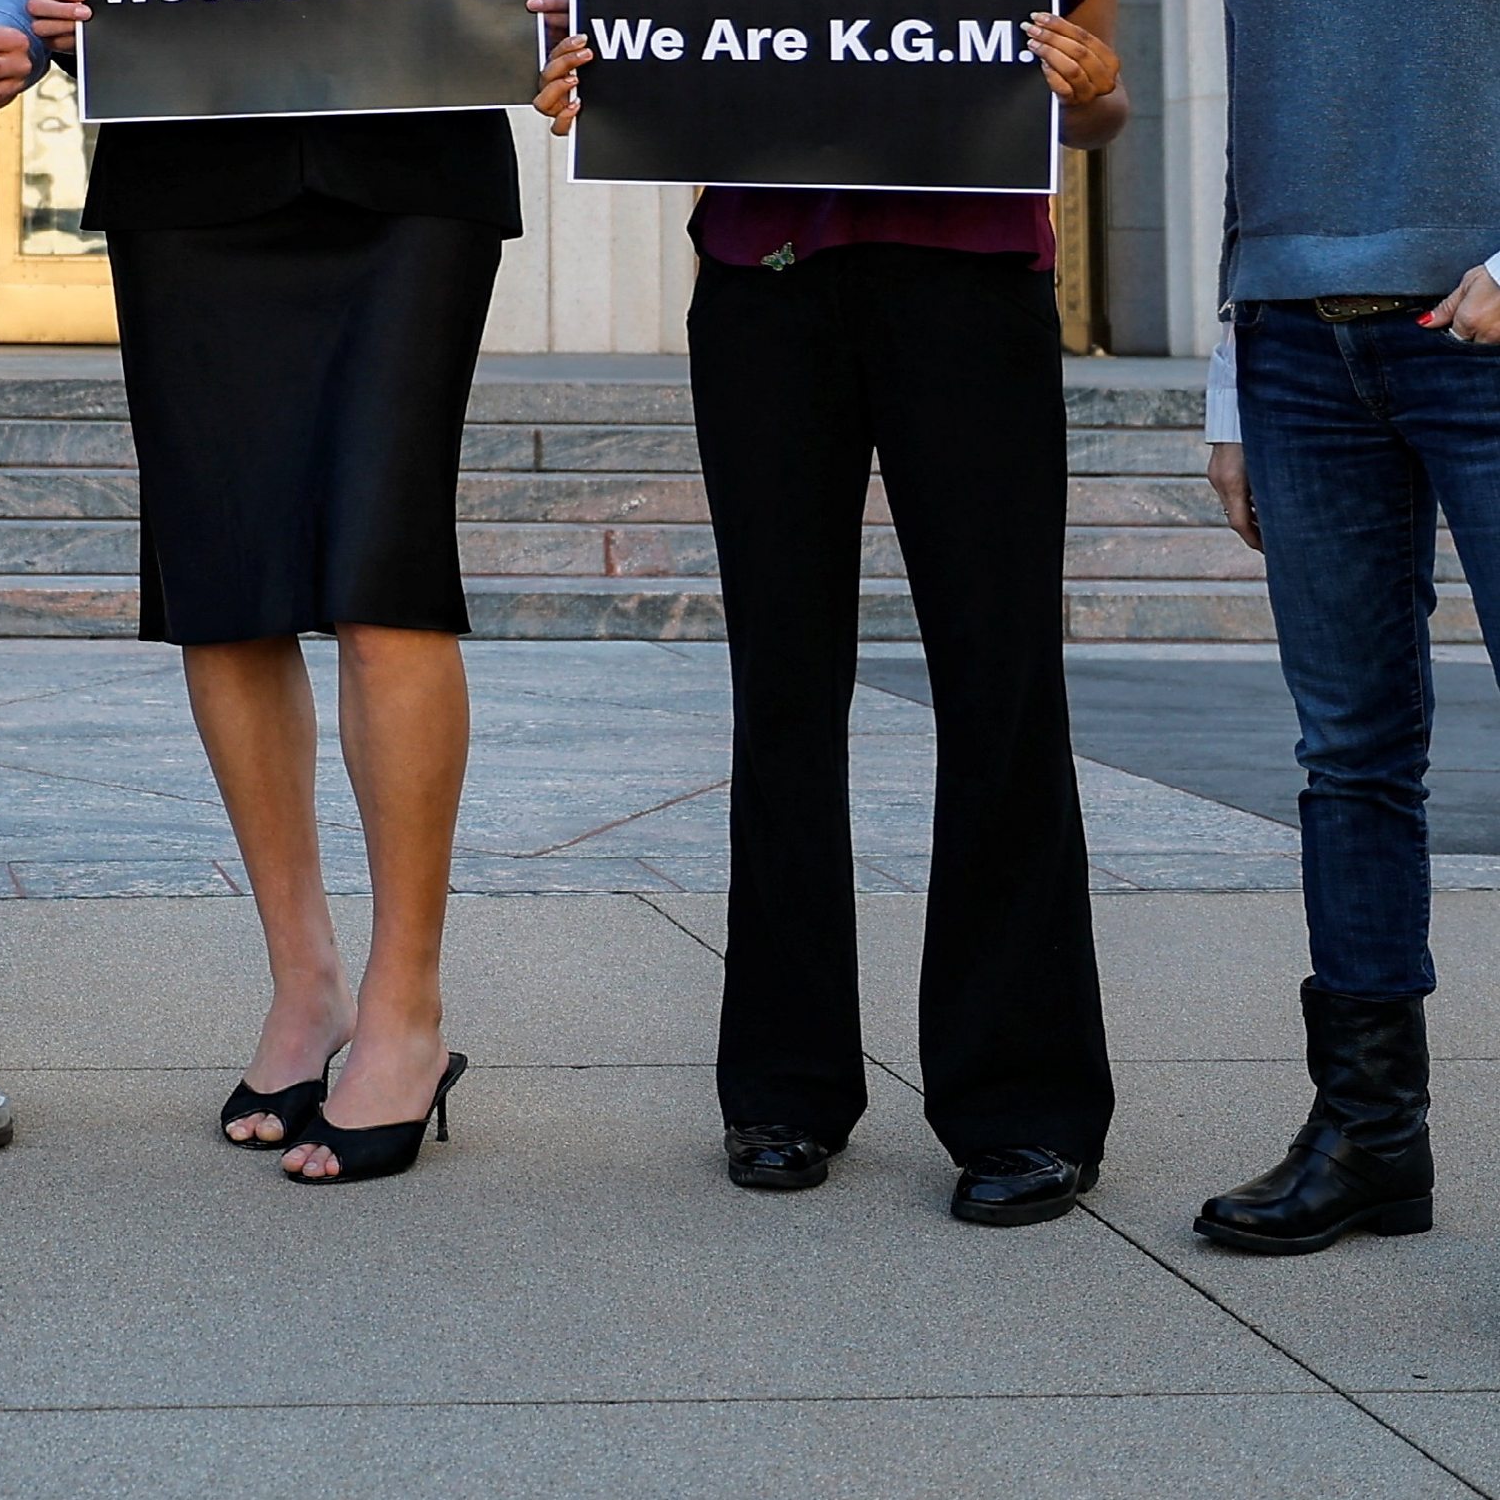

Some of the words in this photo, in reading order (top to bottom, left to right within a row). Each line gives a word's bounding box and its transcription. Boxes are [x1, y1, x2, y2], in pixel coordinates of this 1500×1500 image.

[590, 17, 684, 61] We
[701, 18, 808, 62] Are
[829, 18, 1035, 63] K.G.M.
